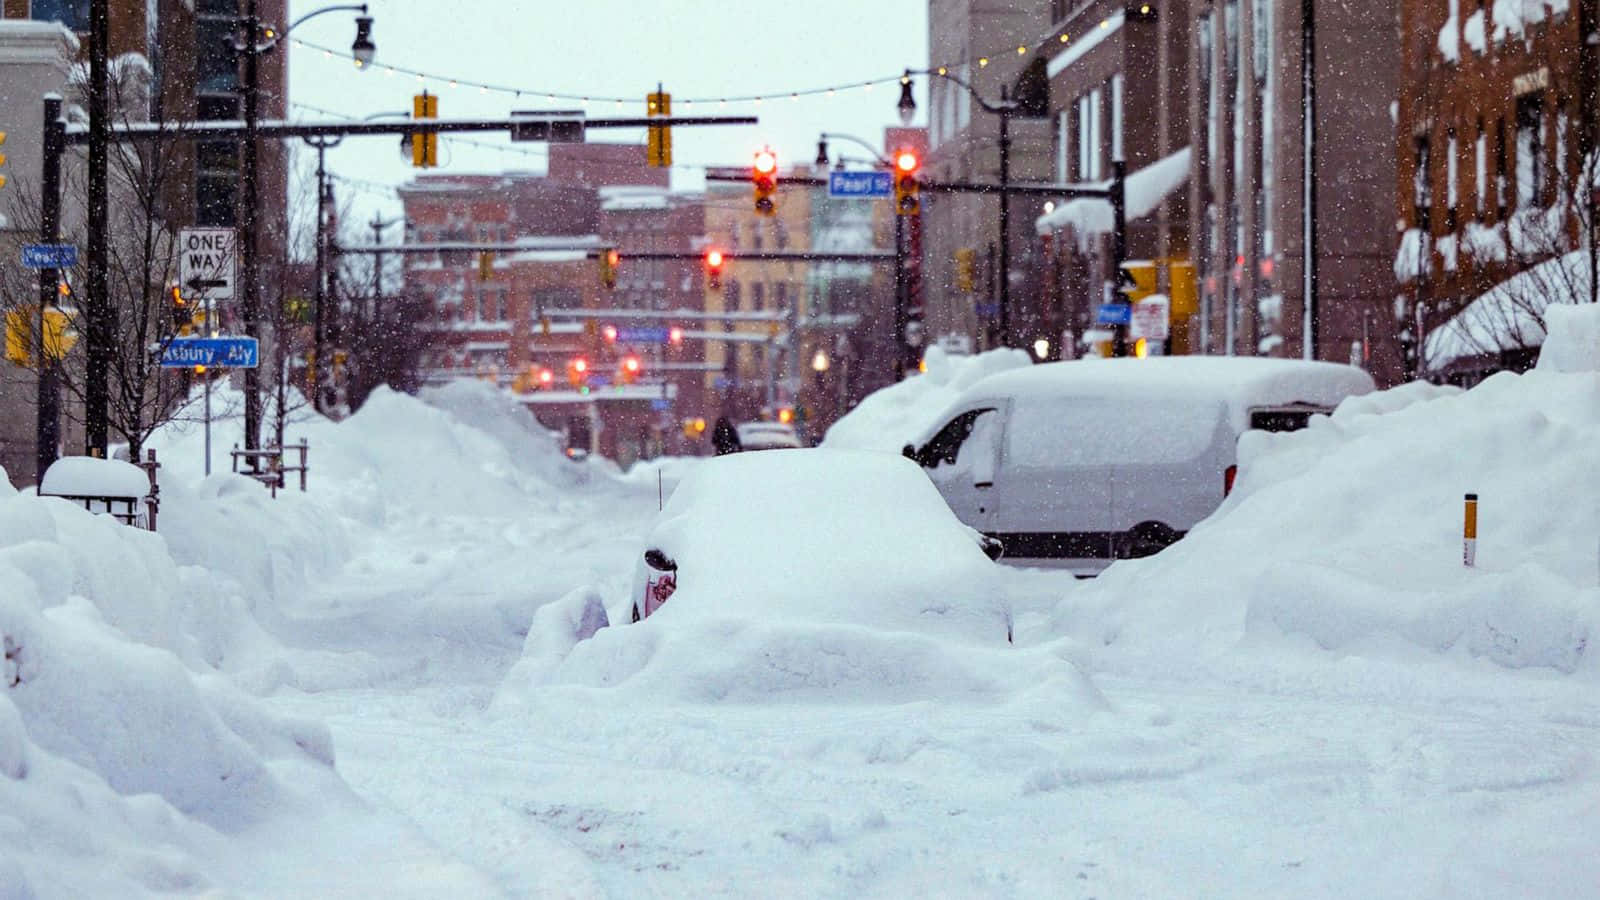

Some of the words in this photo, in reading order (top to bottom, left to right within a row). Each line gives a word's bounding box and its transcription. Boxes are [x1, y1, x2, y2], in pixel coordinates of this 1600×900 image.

[189, 235, 225, 250] ONE
[189, 254, 225, 270] WAY
[162, 346, 215, 364] Asbury
[228, 345, 253, 365] Aly
